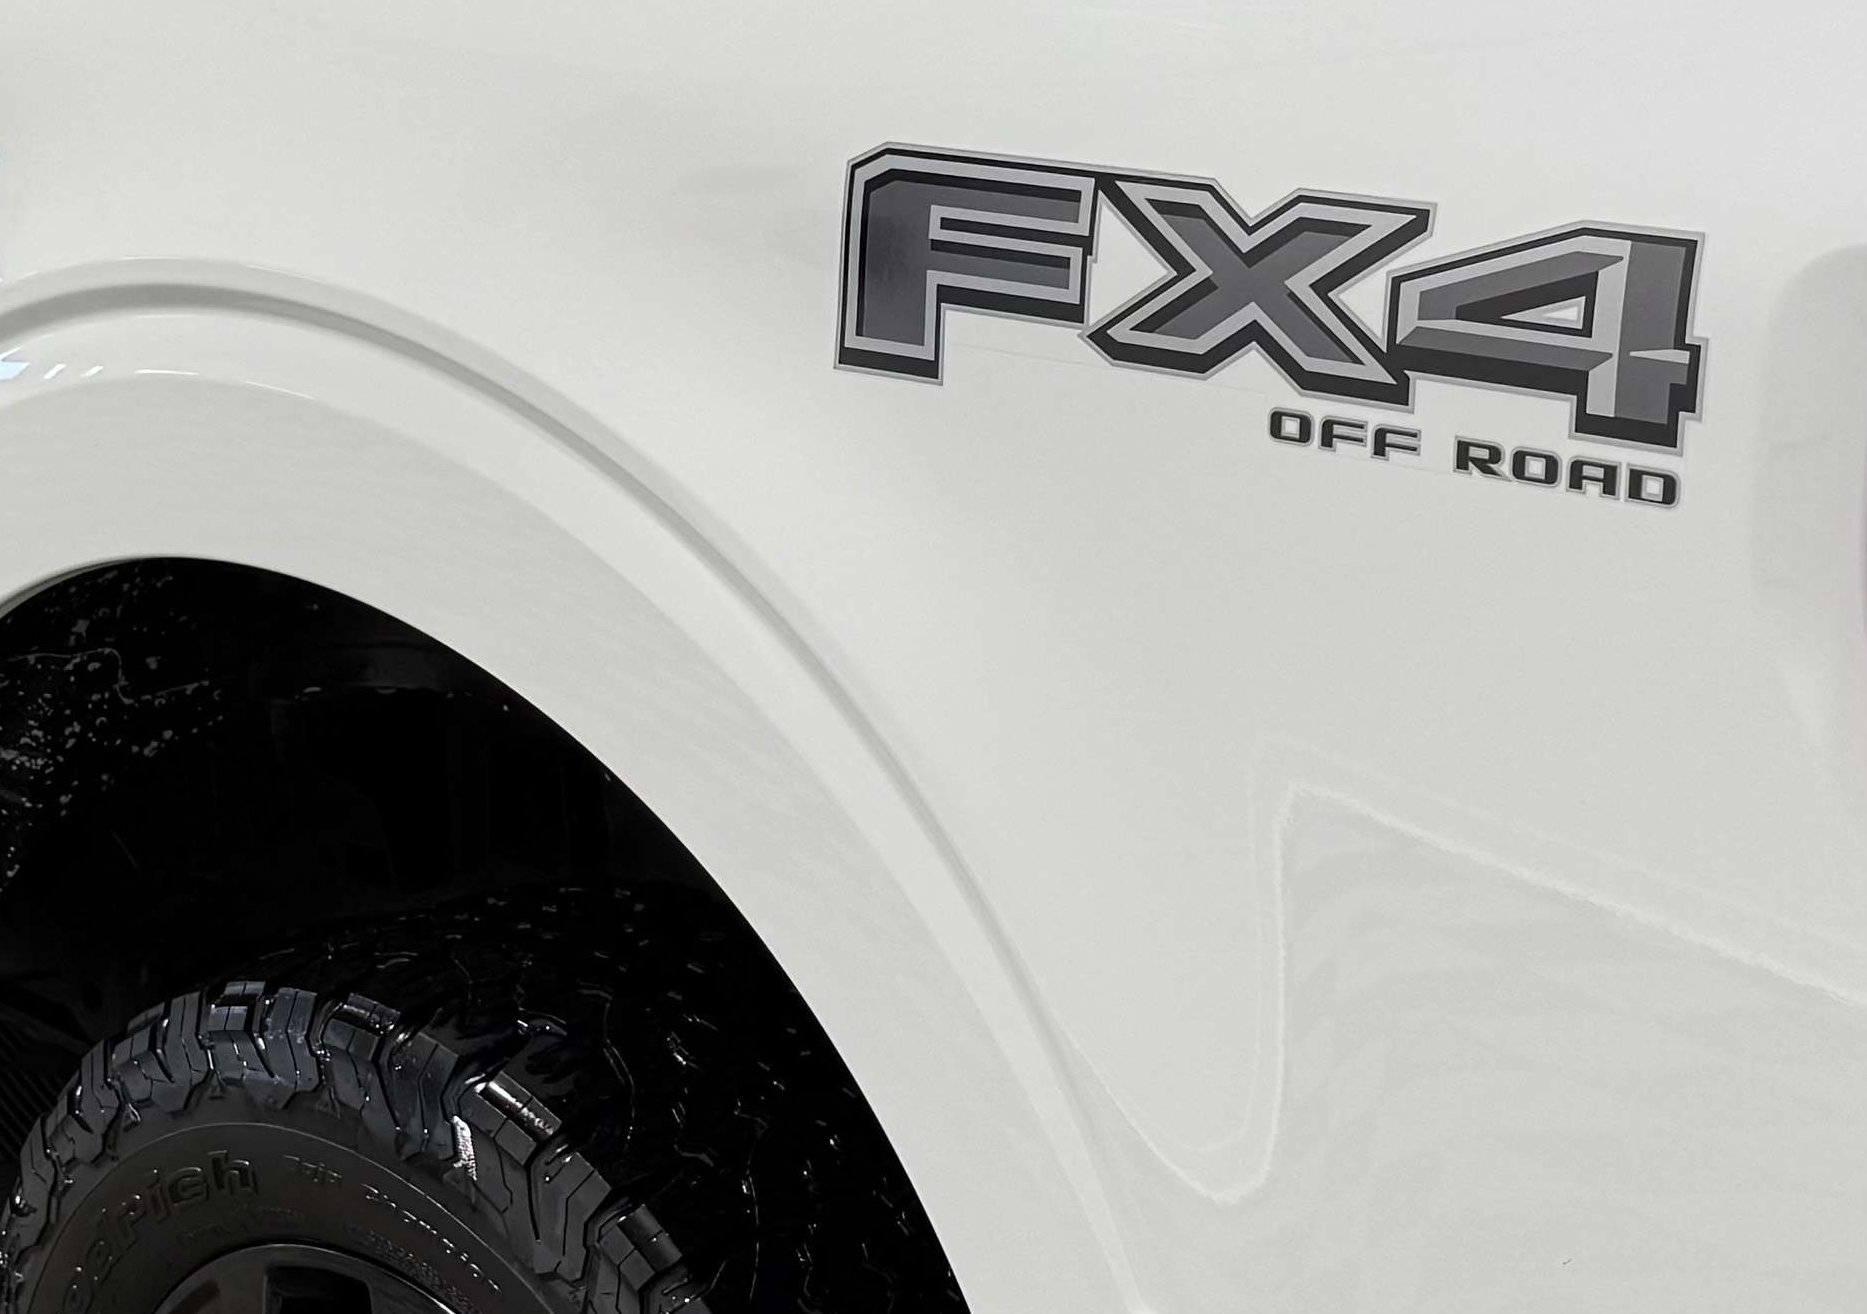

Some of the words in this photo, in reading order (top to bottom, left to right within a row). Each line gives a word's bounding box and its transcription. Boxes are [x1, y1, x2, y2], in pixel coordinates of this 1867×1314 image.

[832, 141, 1712, 456] FX4
[1267, 405, 1424, 464] OFF
[1451, 433, 1683, 512] ROAD
